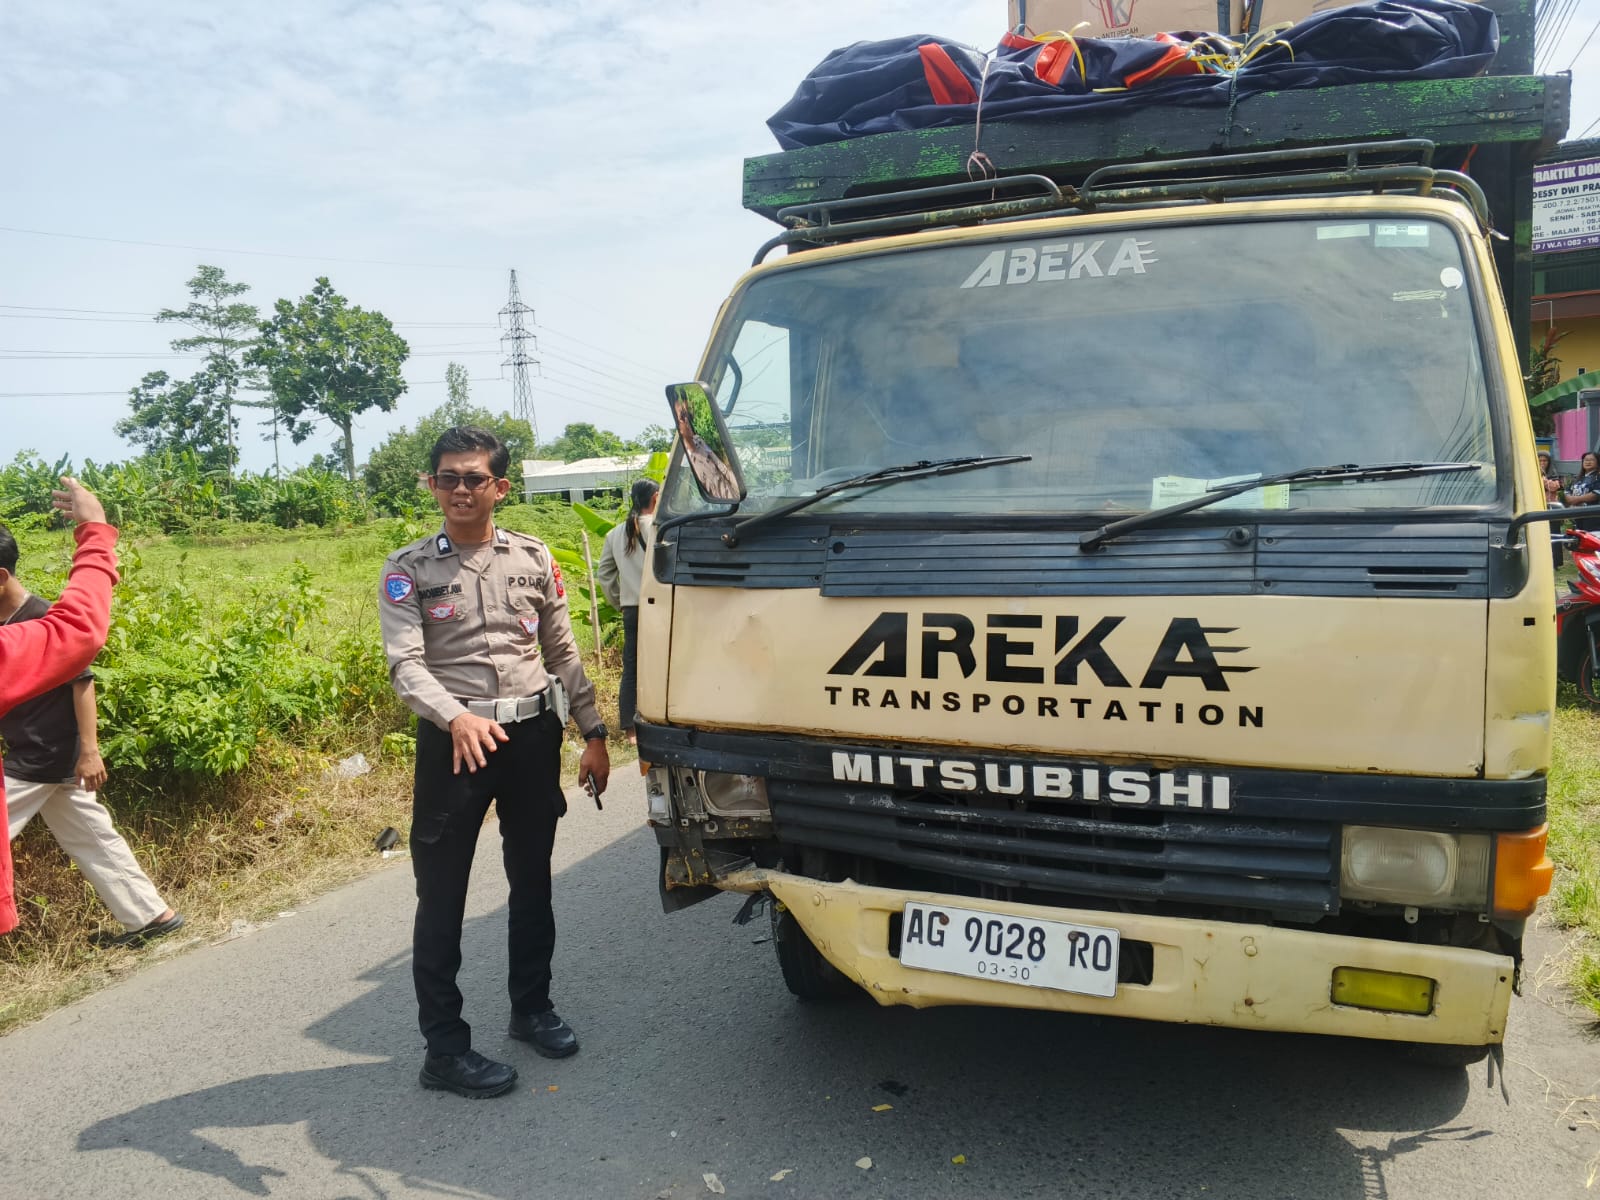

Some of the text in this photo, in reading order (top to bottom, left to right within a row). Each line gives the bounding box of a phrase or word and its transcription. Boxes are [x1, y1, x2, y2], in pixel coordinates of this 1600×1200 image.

[1561, 185, 1580, 195] DWI
[1532, 231, 1545, 239] RE
[1551, 227, 1580, 236] MALAM
[1550, 213, 1574, 222] SENIN
[960, 238, 1159, 289] ABEKA
[827, 612, 1261, 692] AREKA
[825, 686, 1265, 728] TRANSPORTATION
[831, 751, 1231, 810] MITSUBISHI
[906, 908, 949, 948] AG
[964, 916, 1046, 963] 9028
